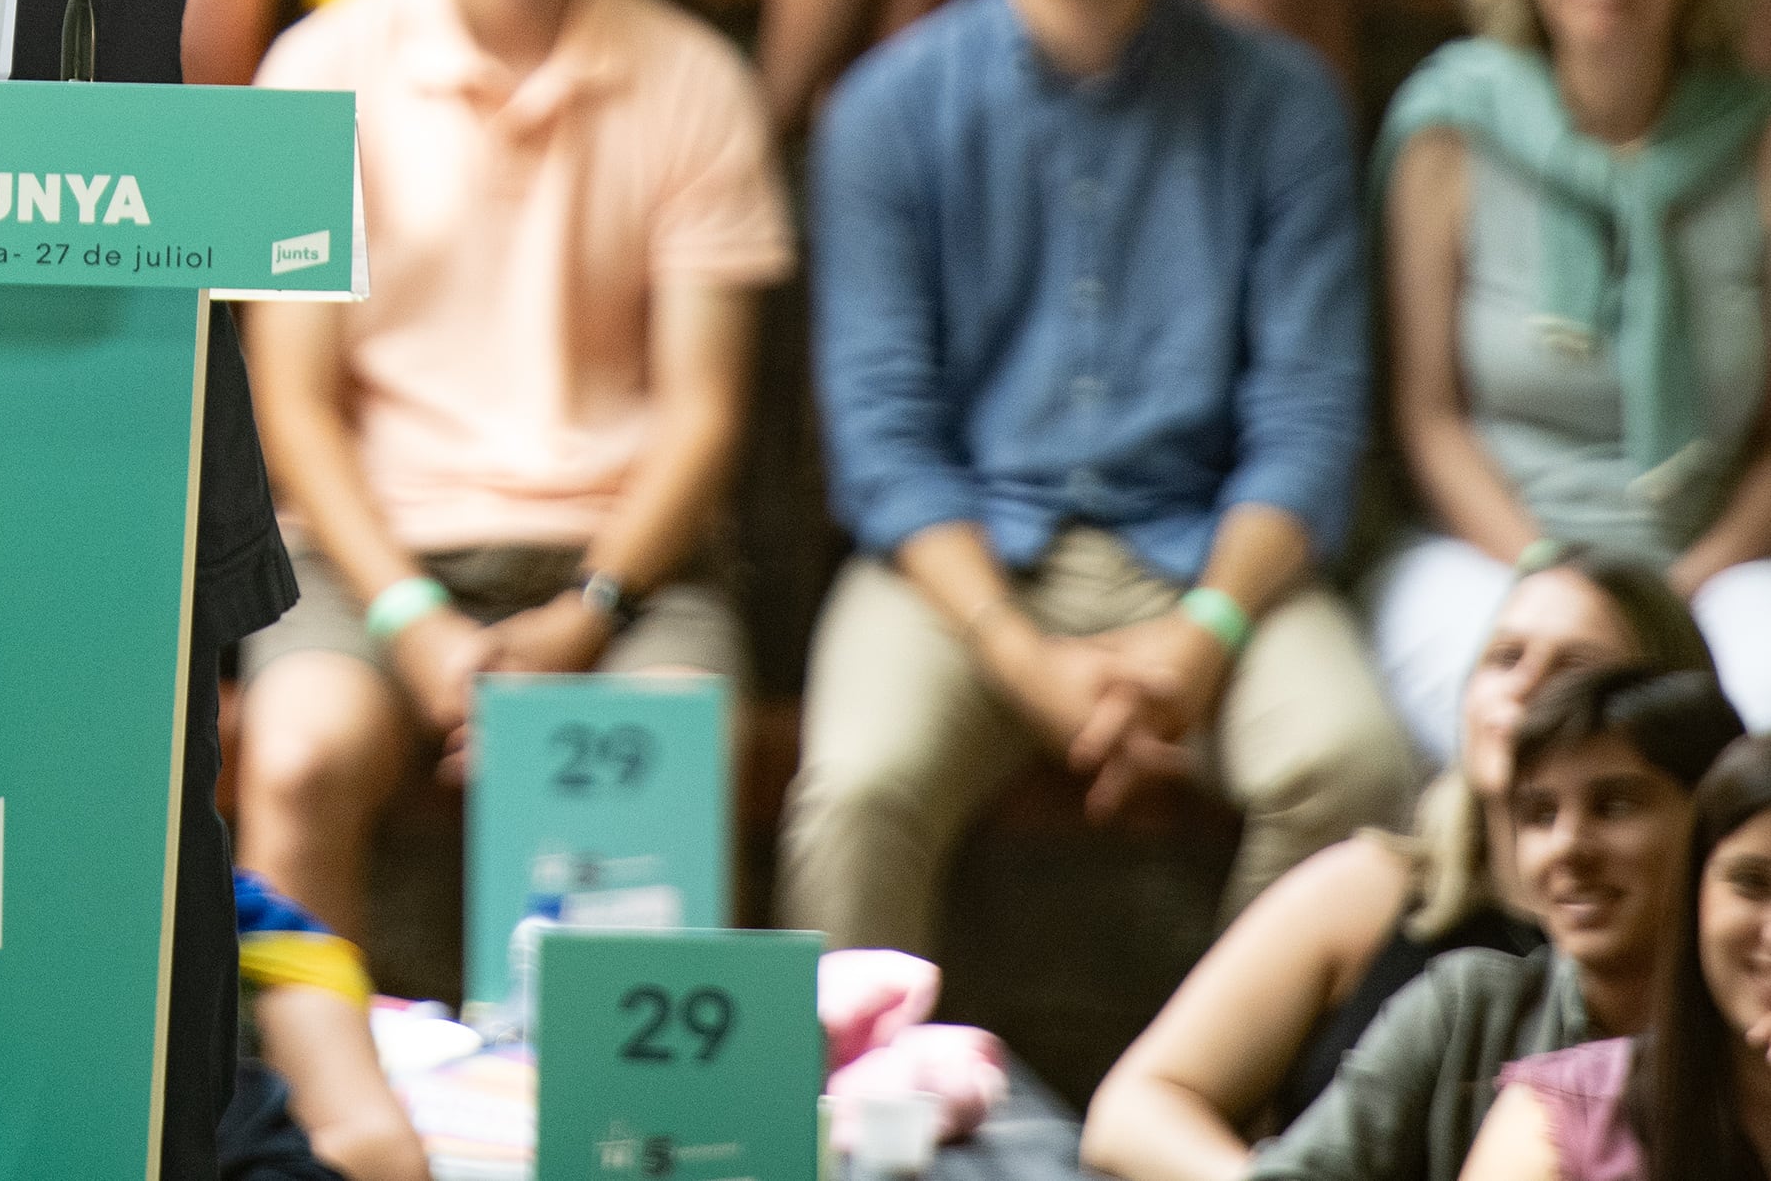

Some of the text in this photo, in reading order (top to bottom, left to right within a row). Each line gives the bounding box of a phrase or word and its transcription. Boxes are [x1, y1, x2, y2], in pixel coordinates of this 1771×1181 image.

[35, 242, 70, 266] 27
[83, 242, 122, 267] de
[133, 244, 213, 273] juliol
[276, 245, 320, 263] junts
[548, 721, 659, 793] 29
[618, 984, 737, 1065] 29
